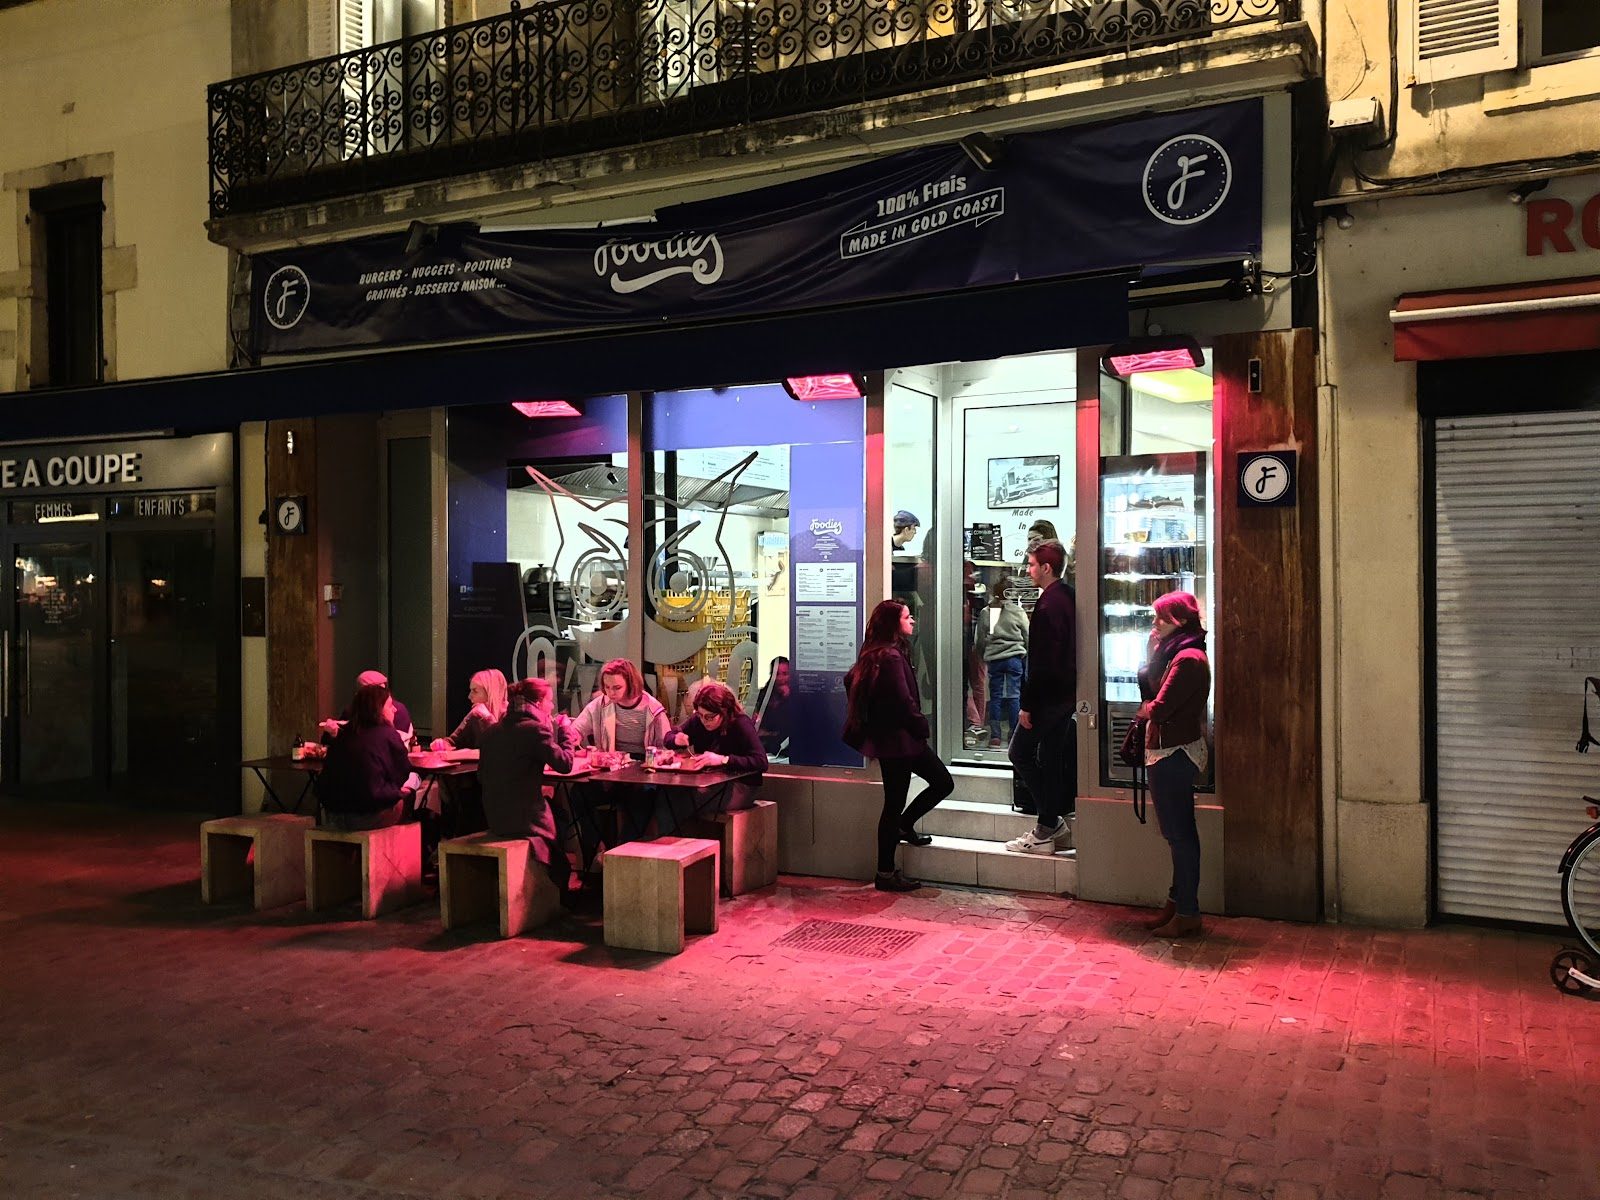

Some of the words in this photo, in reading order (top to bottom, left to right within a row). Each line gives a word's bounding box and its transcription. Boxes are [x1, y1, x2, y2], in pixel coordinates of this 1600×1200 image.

[876, 189, 919, 217] 100%
[923, 175, 967, 202] Frais
[848, 230, 888, 254] MADE
[891, 224, 907, 241] IN
[911, 211, 948, 234] GOLD
[952, 194, 999, 220] COAST
[359, 269, 402, 285] BURGERS
[411, 264, 455, 279] NUGGETS
[463, 256, 513, 273] POUTINES
[365, 284, 407, 302] GRATINÉS
[414, 281, 459, 297] DESSERTS
[0, 459, 17, 488] E
[21, 458, 41, 488] A
[46, 452, 138, 487] COUPE
[35, 503, 73, 519] FEMMES
[138, 498, 185, 516] ENFANTS
[1011, 509, 1034, 517] Made
[809, 518, 843, 536] Foodies
[1018, 521, 1027, 530] In
